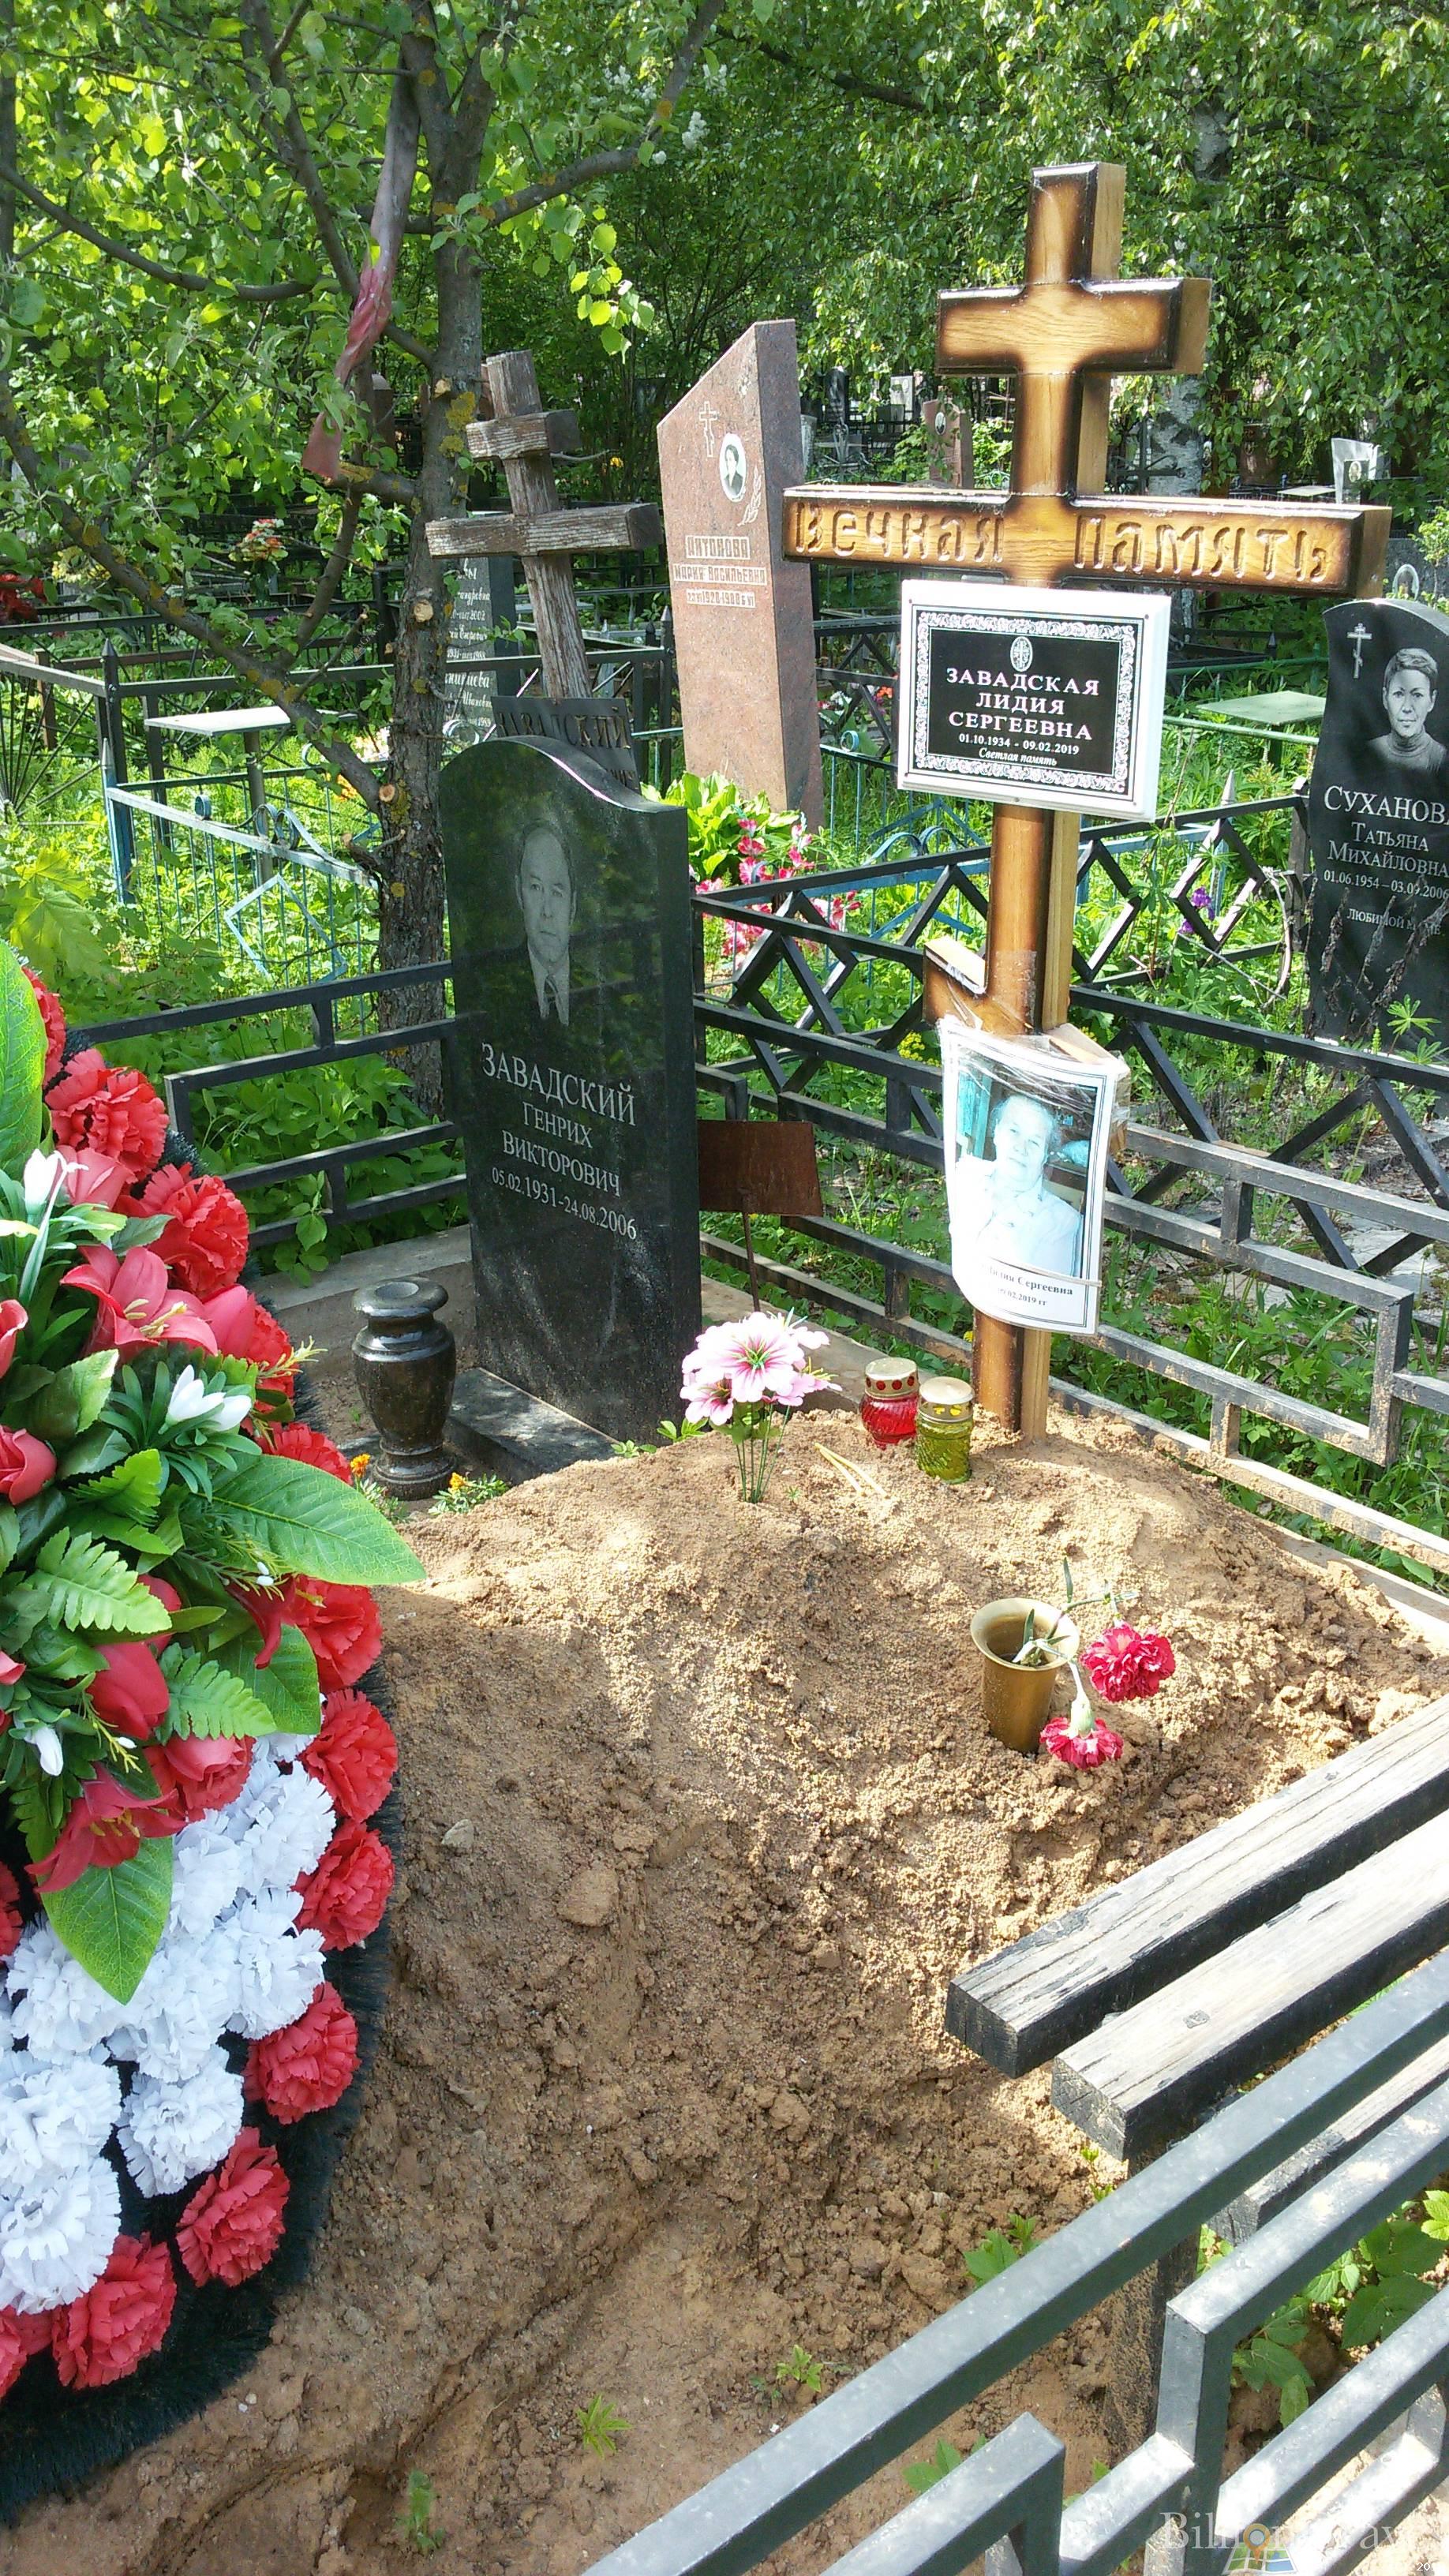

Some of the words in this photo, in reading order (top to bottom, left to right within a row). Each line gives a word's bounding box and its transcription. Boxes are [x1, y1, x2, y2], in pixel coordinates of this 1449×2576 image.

[795, 502, 1005, 564] Вечная
[708, 567, 766, 584] ВАСИЛЬЕВНА
[946, 668, 1099, 695] ЗАВАДСКАЯ
[975, 692, 1065, 715] ЛИДИЯ
[949, 712, 1093, 740] СЕРГЕЕВНА
[959, 733, 1010, 748] 01.10.1934
[1023, 739, 1080, 755] 09.02.2019
[979, 748, 1018, 763] Светлая
[1020, 753, 1058, 767] память
[1324, 785, 1449, 826] СУХАНОВ
[1324, 870, 1380, 889] 01.06.1954
[481, 1043, 636, 1126] ЗАВАДСКИЙ
[522, 1101, 593, 1148] ГЕНРИХ
[502, 1129, 620, 1198] ВИКТОРОВИЧ
[492, 1167, 637, 1239] 05.02.1931-24.08.2006
[1017, 1276, 1073, 1295] Сергеевна
